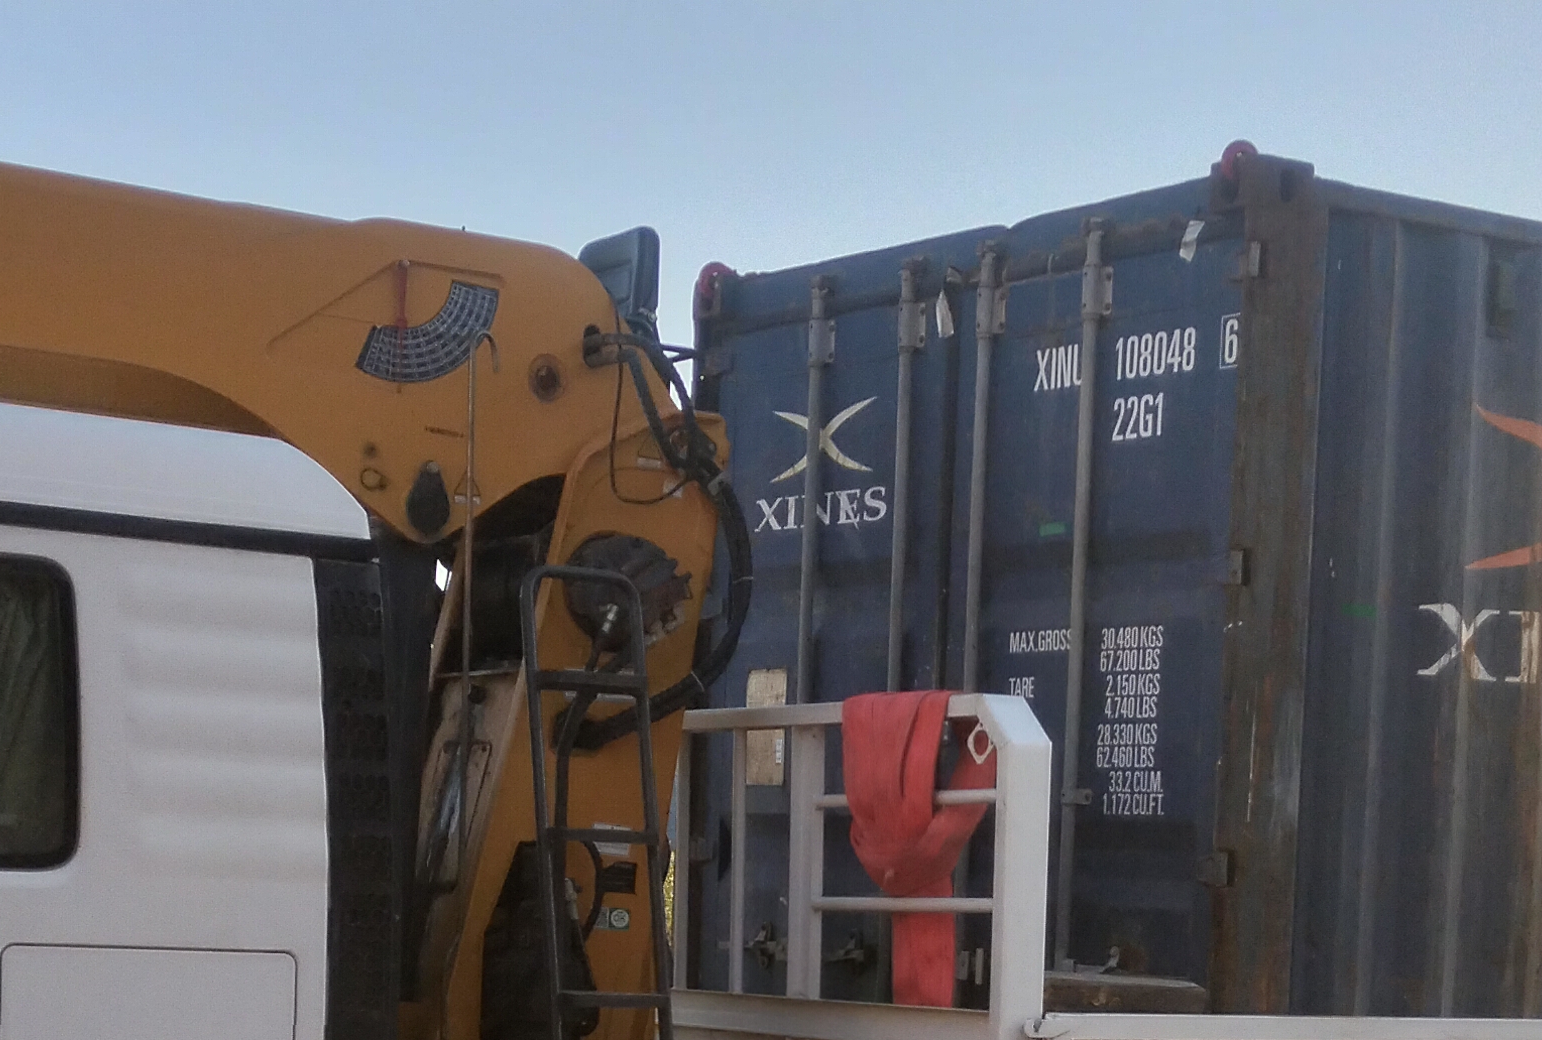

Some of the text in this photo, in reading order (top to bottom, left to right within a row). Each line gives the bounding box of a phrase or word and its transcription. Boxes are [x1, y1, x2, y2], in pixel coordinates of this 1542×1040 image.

[1115, 326, 1196, 381] 108048
[1223, 317, 1239, 364] 6
[1111, 392, 1164, 442] 22G1
[754, 486, 887, 532] XINES
[1101, 626, 1139, 649] 30.480
[1140, 625, 1164, 648] KGS
[1100, 648, 1161, 672] 67.200 LBS
[1009, 673, 1161, 698] TARE 2.150 KGS
[1104, 696, 1158, 719] 4.740 LBS
[1097, 723, 1158, 746] 28.330 KGS
[1096, 746, 1155, 768] 62.460 LBS
[1108, 770, 1132, 792] 33.2
[1103, 793, 1132, 815] 1.172
